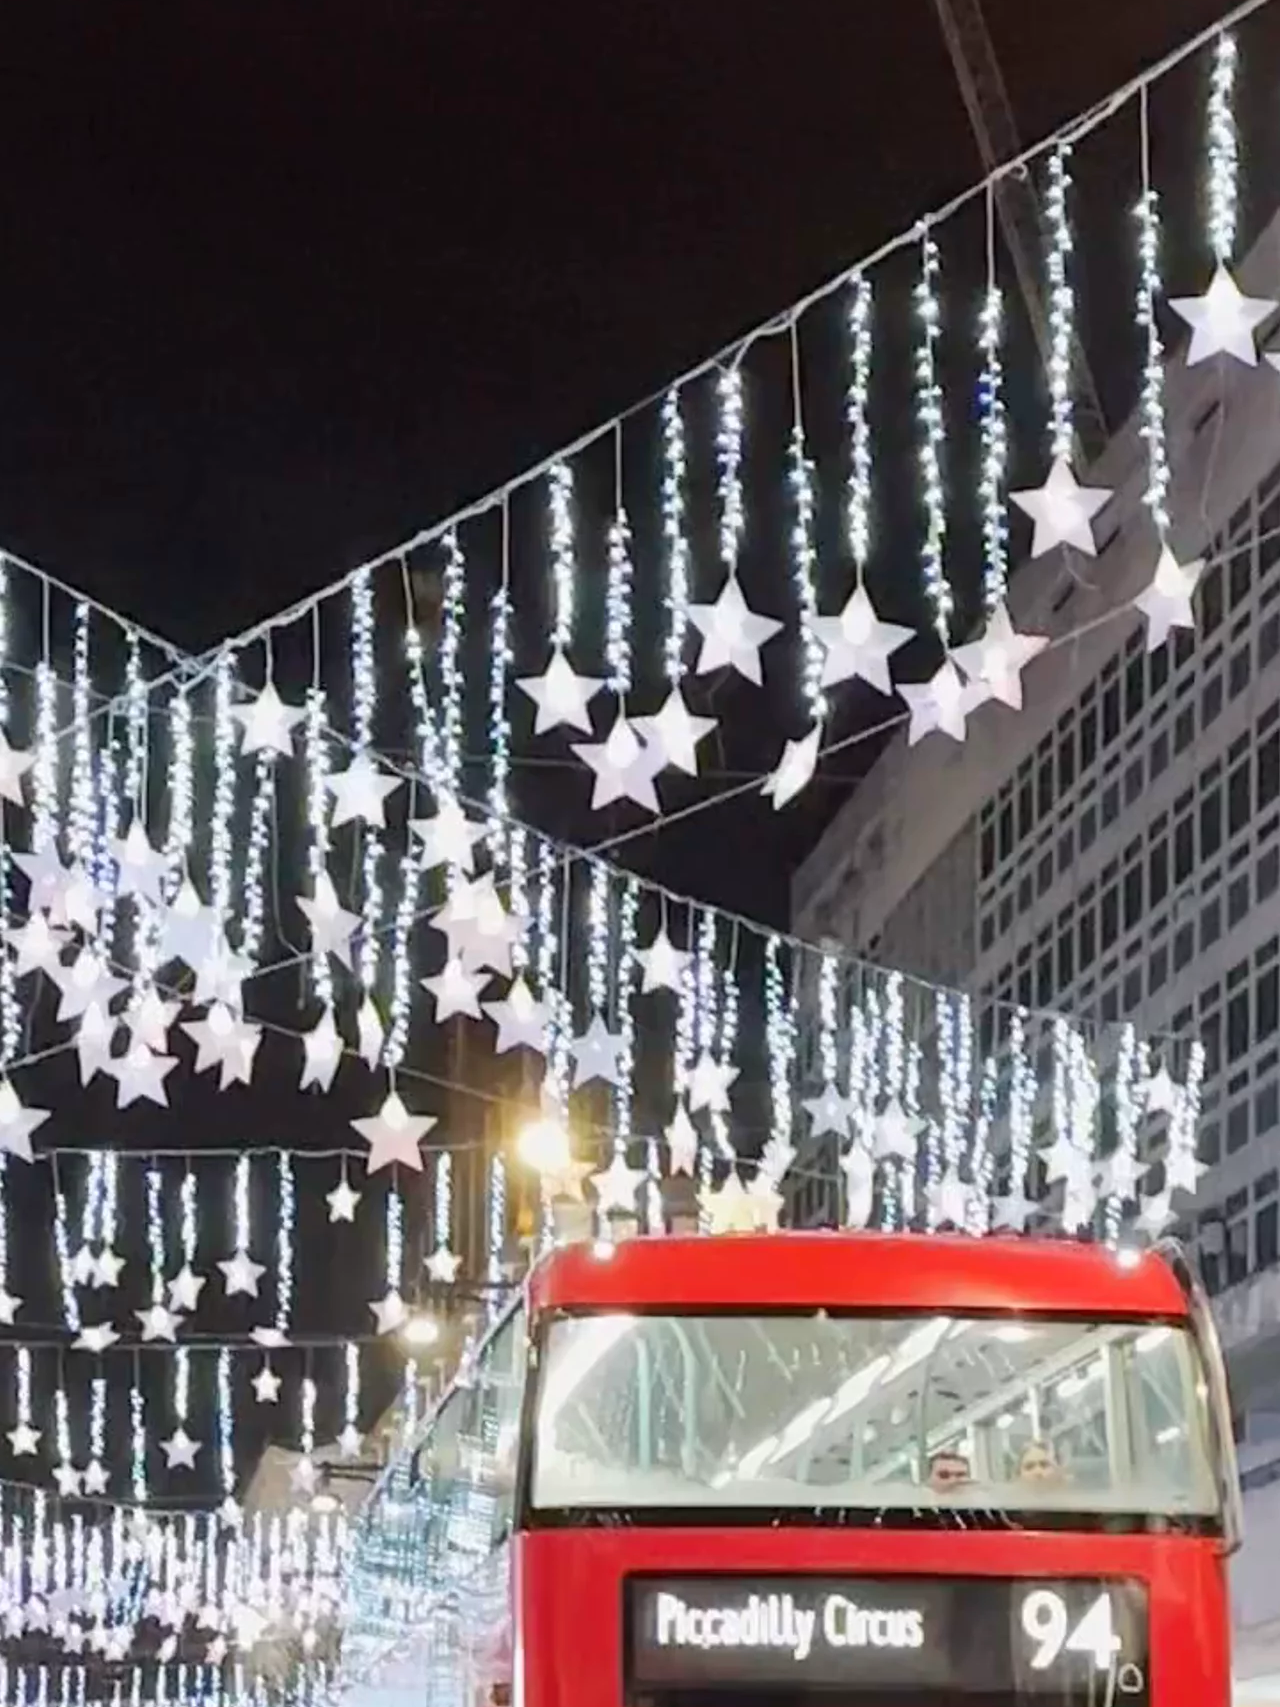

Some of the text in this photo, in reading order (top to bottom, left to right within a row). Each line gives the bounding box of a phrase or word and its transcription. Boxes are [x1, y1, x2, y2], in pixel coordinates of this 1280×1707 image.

[656, 1589, 1122, 1670] Piccadilly Circus 94
